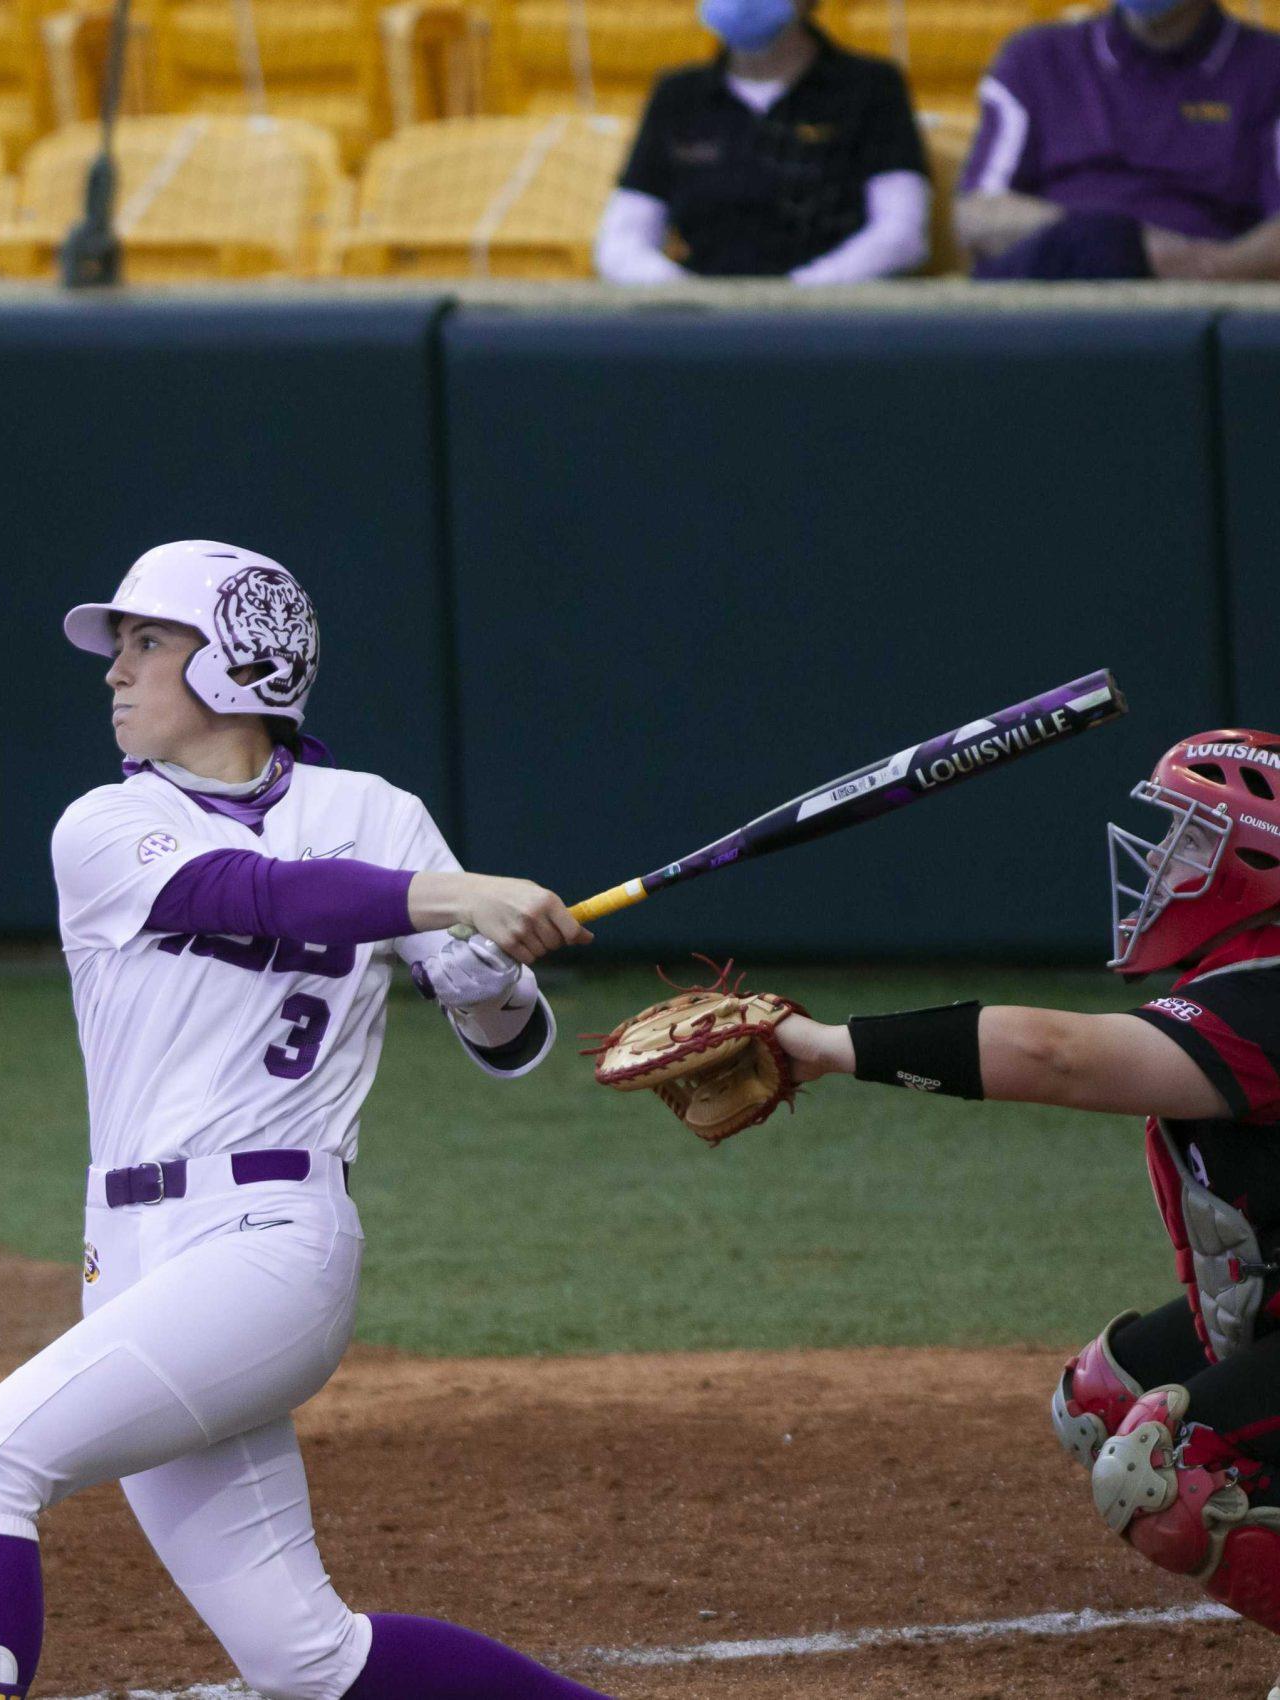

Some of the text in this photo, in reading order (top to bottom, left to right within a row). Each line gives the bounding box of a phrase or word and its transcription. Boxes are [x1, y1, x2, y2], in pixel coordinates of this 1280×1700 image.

[915, 708, 1071, 789] LOUISVILLE
[1239, 813, 1280, 836] LOUISVIL
[263, 992, 331, 1080] 3
[896, 1070, 941, 1087] adidas
